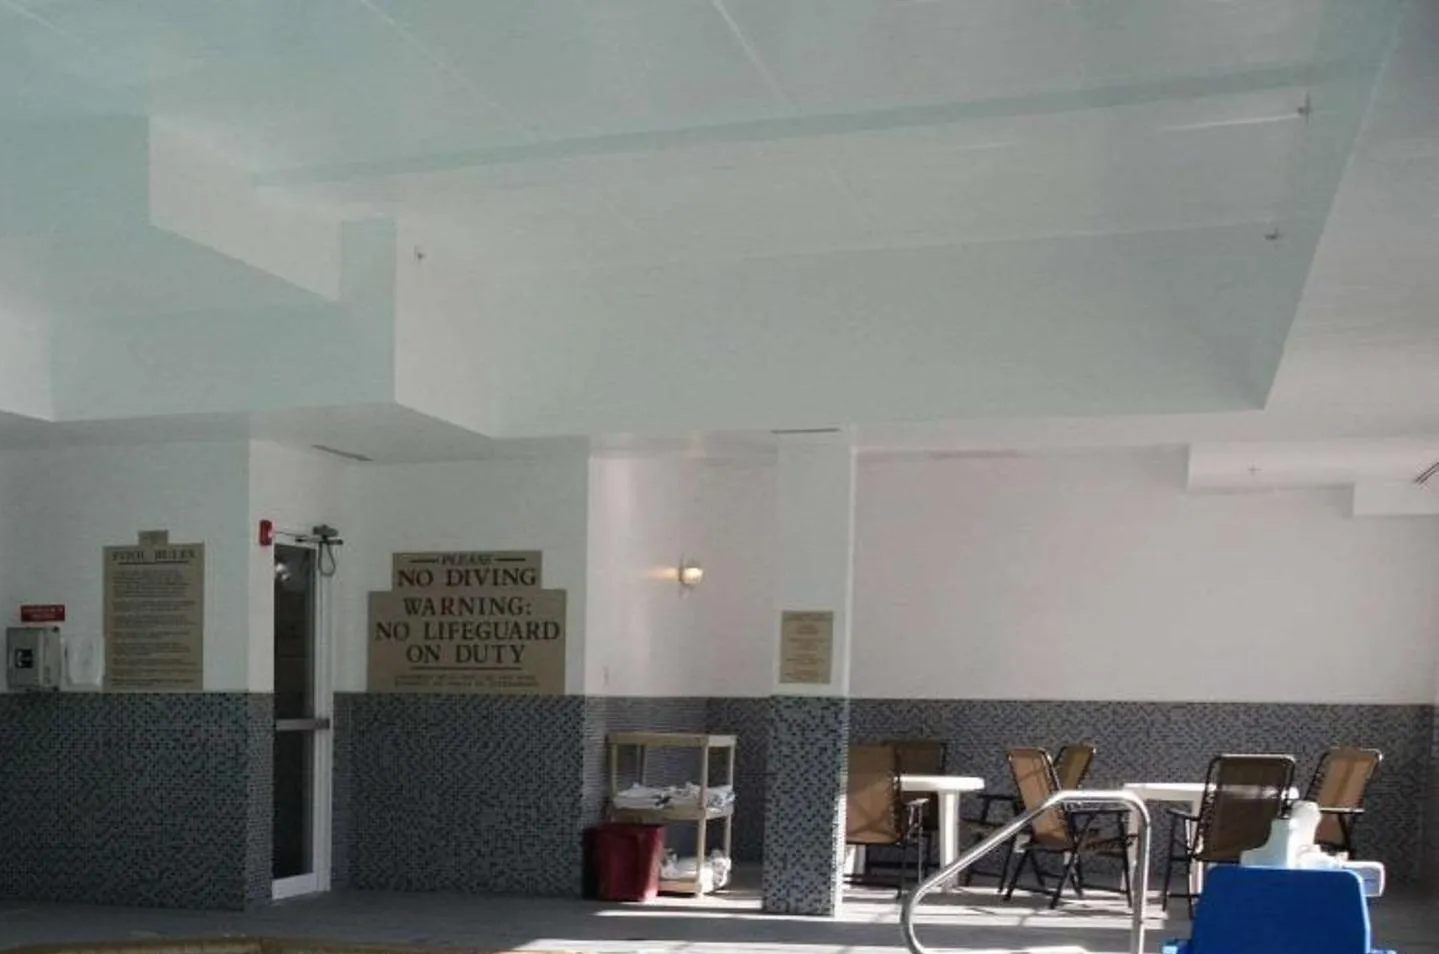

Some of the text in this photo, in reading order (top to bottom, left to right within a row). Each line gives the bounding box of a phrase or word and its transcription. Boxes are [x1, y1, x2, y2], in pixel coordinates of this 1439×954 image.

[397, 567, 536, 588] NO DIVING
[403, 597, 533, 616] WARNING:
[375, 620, 559, 640] NO LIFEGUARD
[406, 644, 526, 663] ON DUTY
